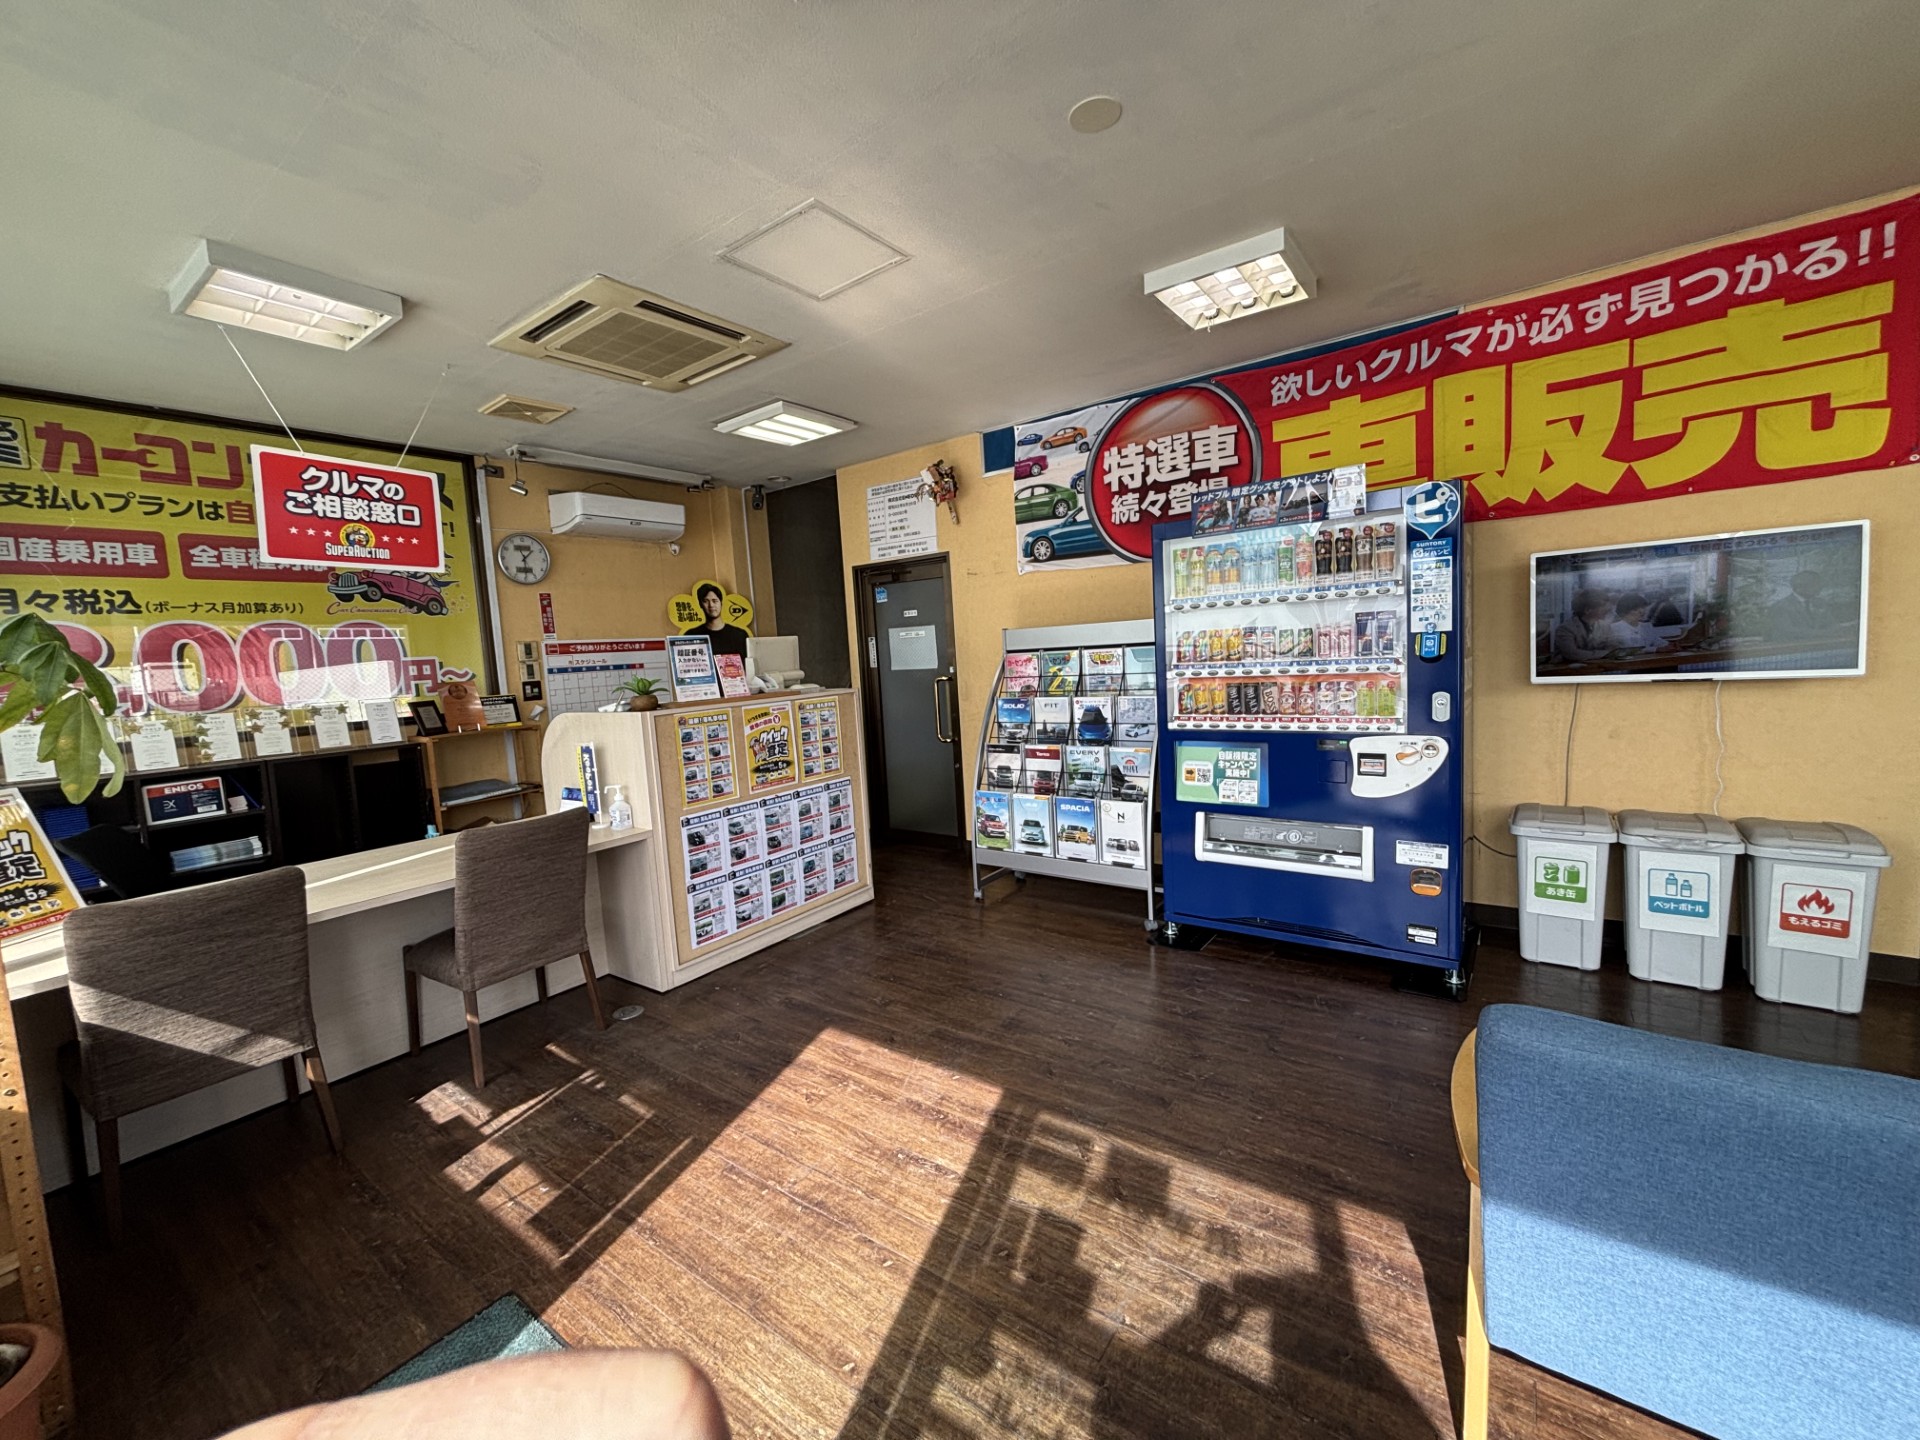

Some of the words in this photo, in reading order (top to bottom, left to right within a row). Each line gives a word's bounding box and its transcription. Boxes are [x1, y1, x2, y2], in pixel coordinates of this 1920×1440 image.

[1271, 221, 1897, 406] 欲しいクルマが必ず見つかる!!
[1272, 280, 1895, 506] 車販売
[1103, 424, 1239, 492] 特選車
[301, 466, 405, 500] クルマの
[1193, 490, 1230, 503] レッドブル
[286, 491, 421, 527] ご相談窓口
[0, 589, 142, 614] 月々税込
[146, 602, 304, 614] (ボーナス月加算あり)
[569, 643, 646, 652] ご予約ありがとうございます
[1264, 690, 1277, 712] BOSS
[760, 727, 788, 743] クイック
[768, 741, 789, 759] 査定
[1219, 751, 1257, 760] 自販機限定
[1218, 760, 1257, 769] キャンペーン
[1225, 769, 1250, 778] 実施中!
[164, 783, 204, 794] ENEOS
[1060, 804, 1090, 812] SPACIA
[1117, 812, 1125, 820] N
[1545, 887, 1576, 899] あき缶
[1653, 901, 1705, 912] ペットボトル
[1788, 916, 1842, 931] もえるゴミ
